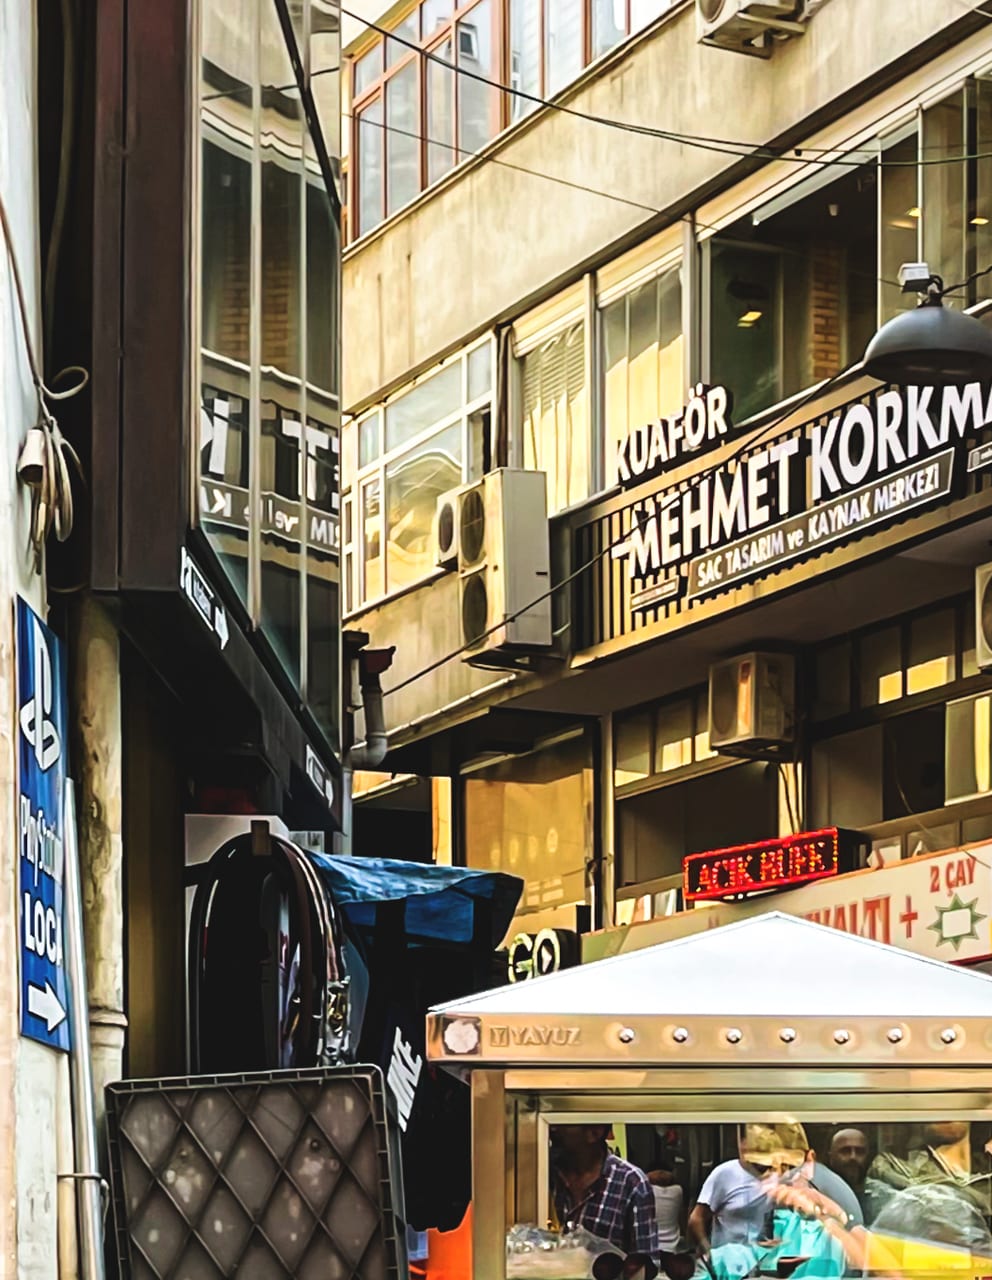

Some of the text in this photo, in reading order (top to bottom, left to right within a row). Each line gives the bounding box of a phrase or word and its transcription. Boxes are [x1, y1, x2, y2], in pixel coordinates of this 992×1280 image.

[615, 382, 727, 482] KUAFÖR
[611, 437, 798, 578] MEHMET
[725, 531, 784, 575] TASARIM
[787, 529, 803, 550] ve
[808, 492, 871, 541] KAYNAK
[930, 857, 977, 897] 2 ÇAY
[511, 1025, 580, 1046] YAVUZ
